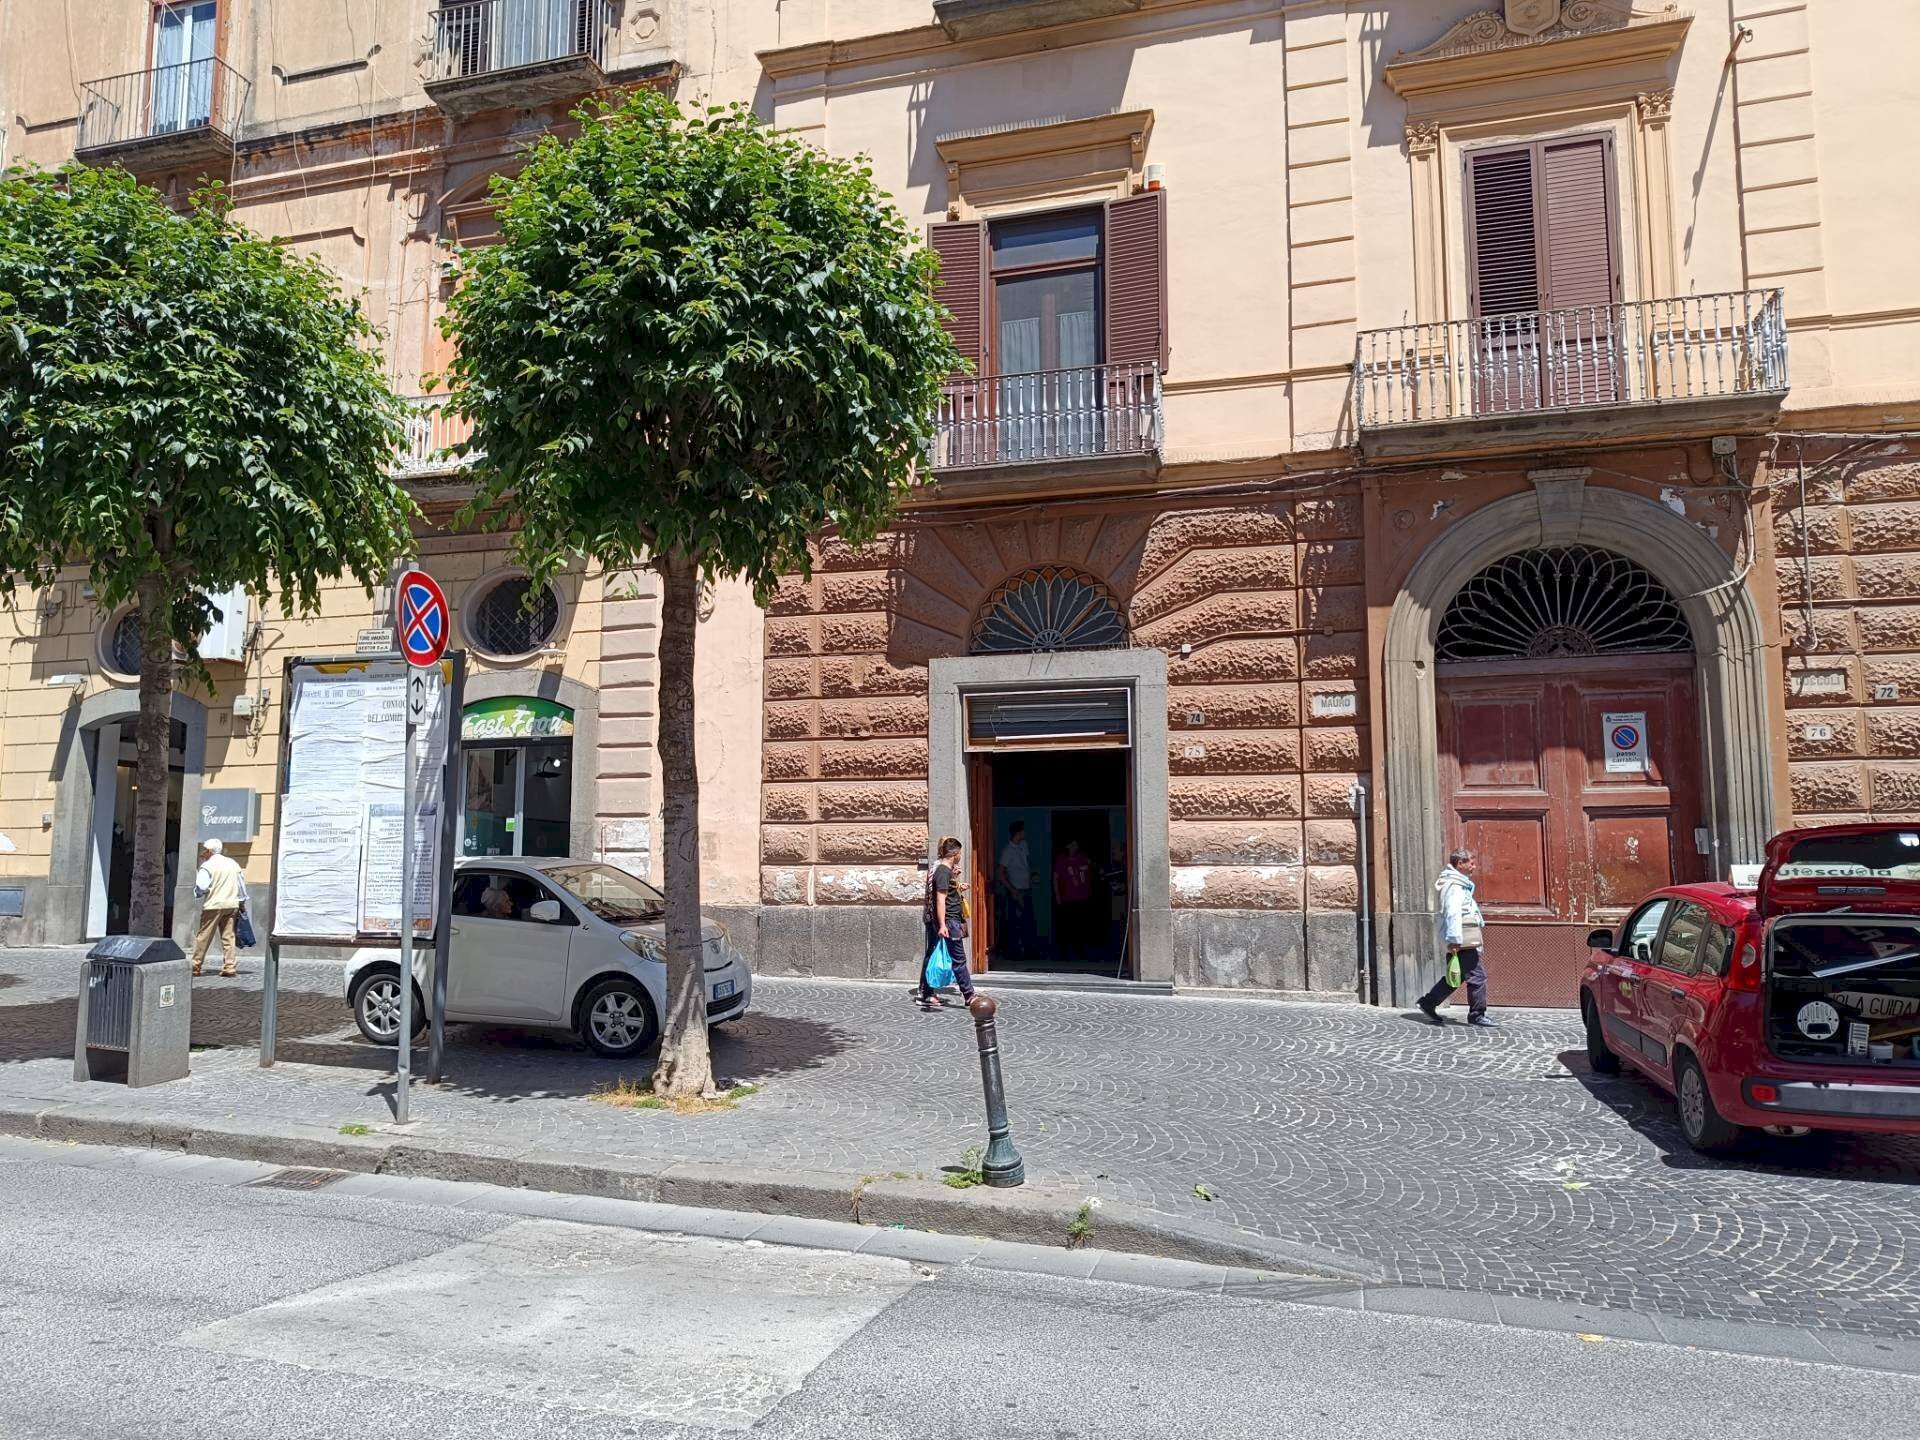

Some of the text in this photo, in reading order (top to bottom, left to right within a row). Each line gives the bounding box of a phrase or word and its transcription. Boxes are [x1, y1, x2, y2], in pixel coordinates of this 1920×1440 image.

[1880, 687, 1894, 698] 72
[1321, 698, 1351, 708] MAURO
[462, 705, 565, 736] Fast Food
[1190, 713, 1201, 723] 74
[1810, 727, 1826, 738] 76
[1778, 867, 1892, 877] utoscuola
[1869, 997, 1914, 1017] GUIDA
